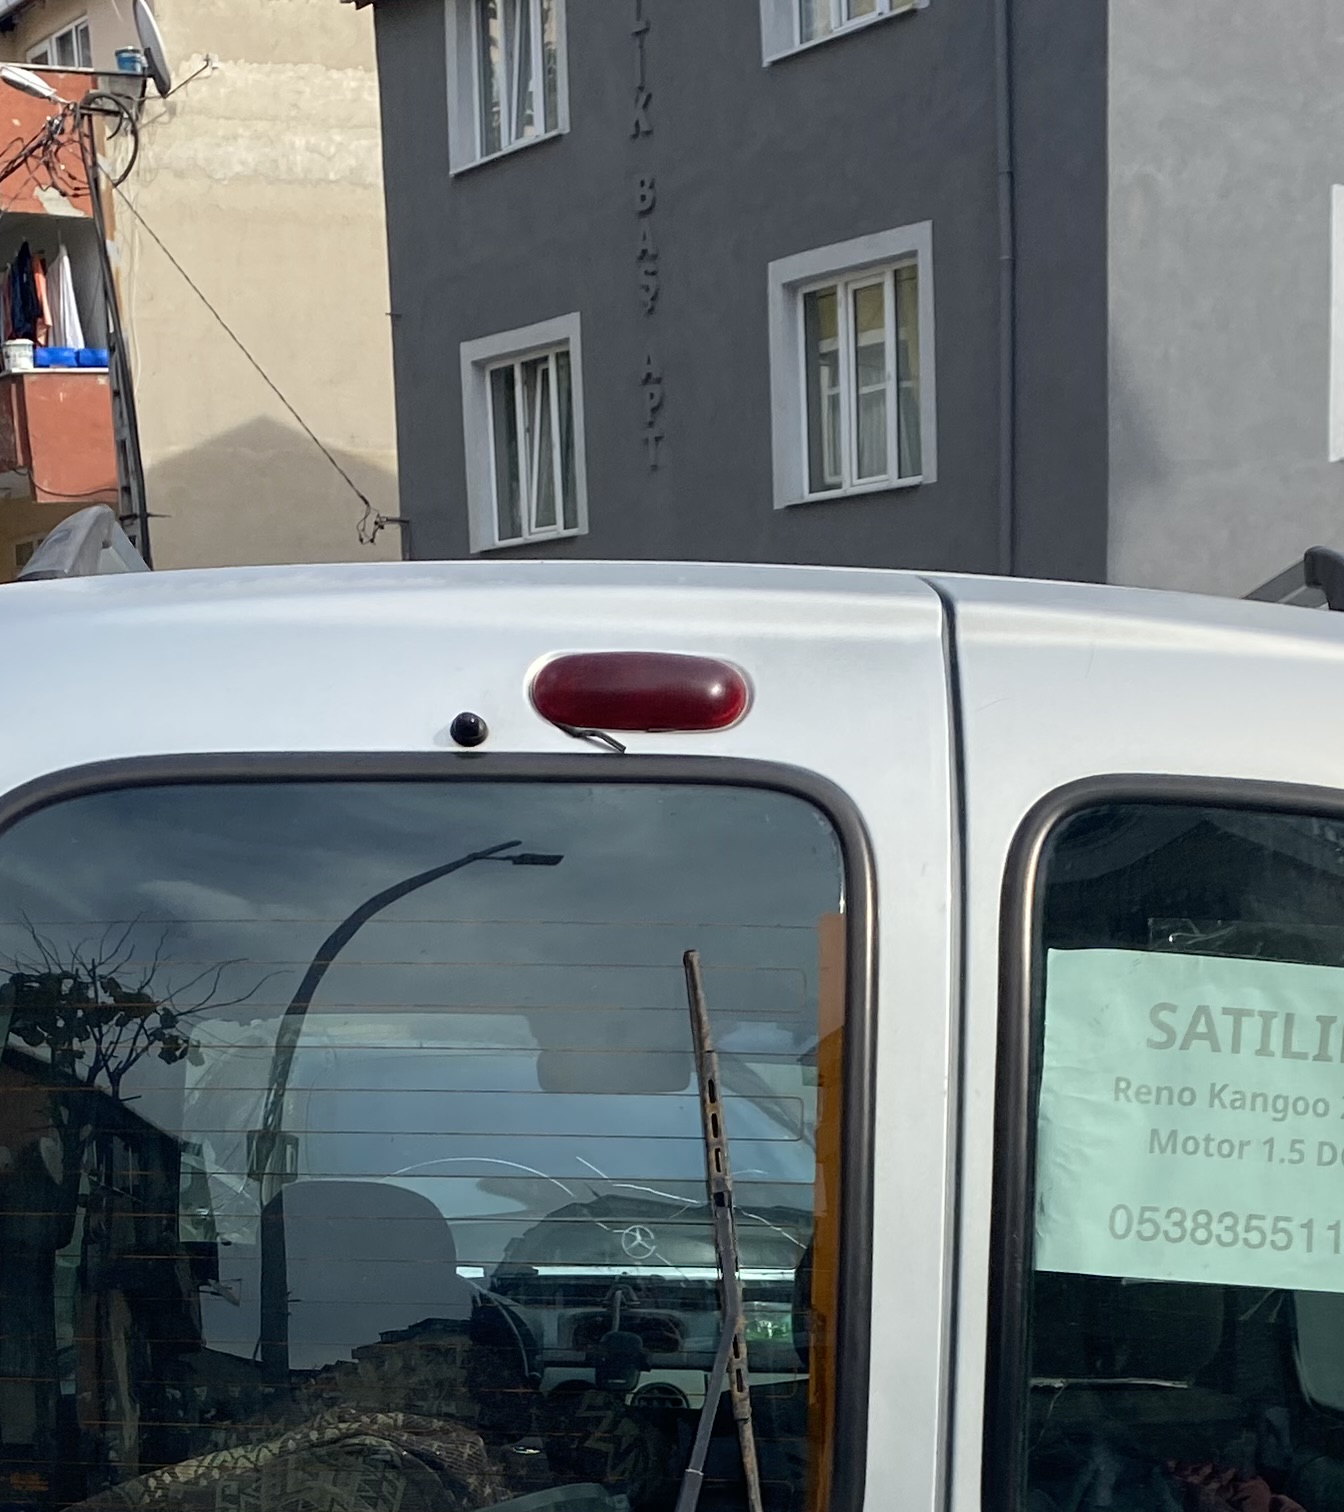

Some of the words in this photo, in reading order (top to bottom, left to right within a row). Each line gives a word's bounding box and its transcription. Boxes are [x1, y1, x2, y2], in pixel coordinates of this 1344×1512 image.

[1113, 1077, 1197, 1107] Reno
[1208, 1083, 1330, 1122] Kangoo
[1148, 1128, 1250, 1161] Motor
[1262, 1137, 1306, 1165] 1.5
